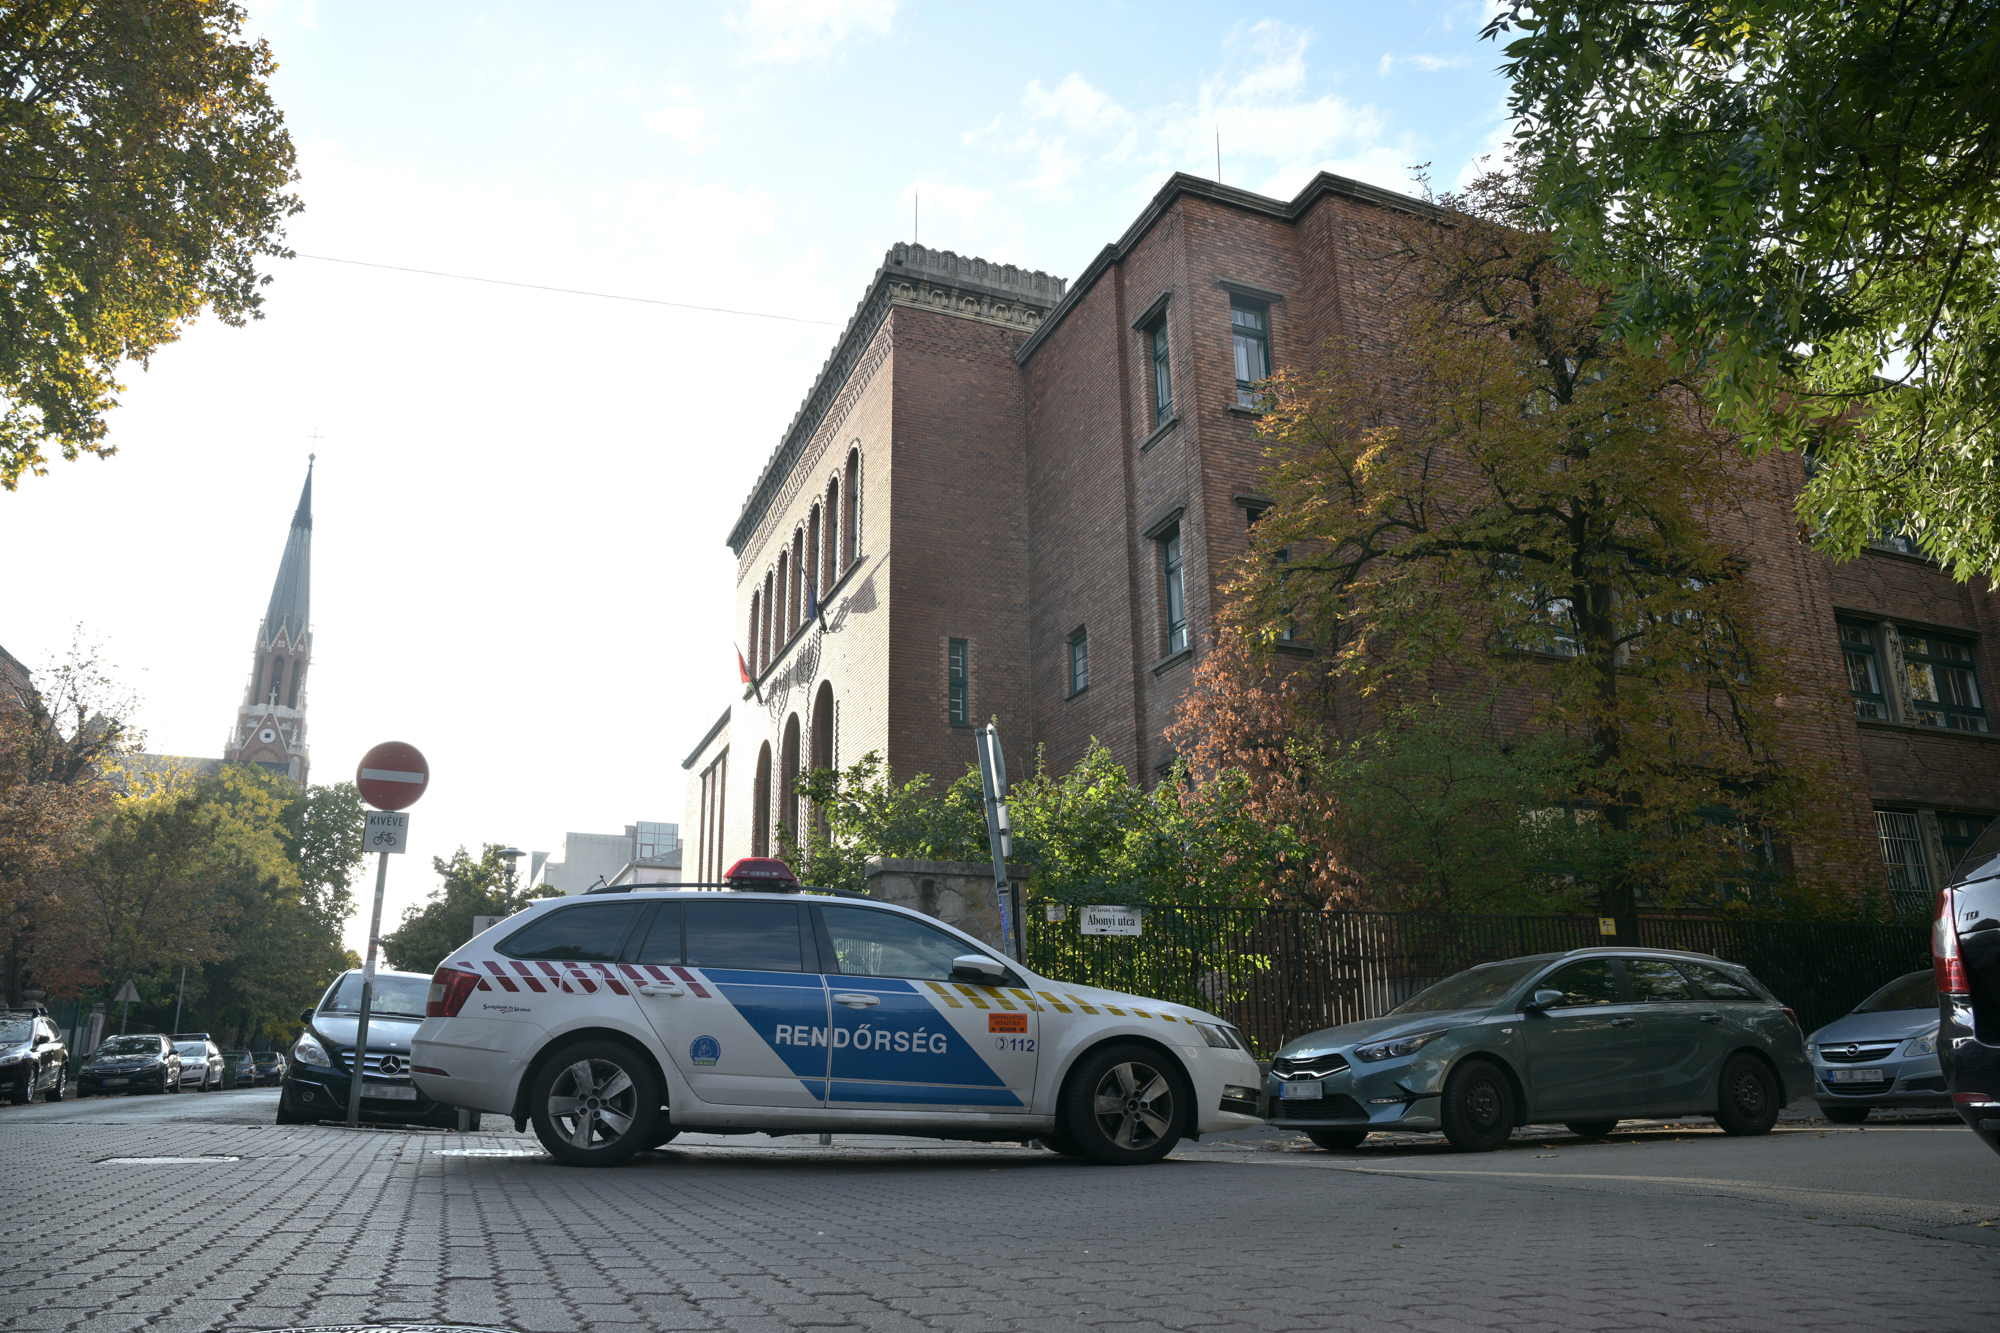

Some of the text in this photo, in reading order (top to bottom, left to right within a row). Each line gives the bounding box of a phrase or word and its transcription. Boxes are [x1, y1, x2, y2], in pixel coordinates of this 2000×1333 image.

[370, 814, 404, 827] KIVÉVE
[1087, 914, 1135, 928] Abonyi utca
[775, 1024, 947, 1054] RENDŐRSÉG
[1010, 1038, 1035, 1052] 112
